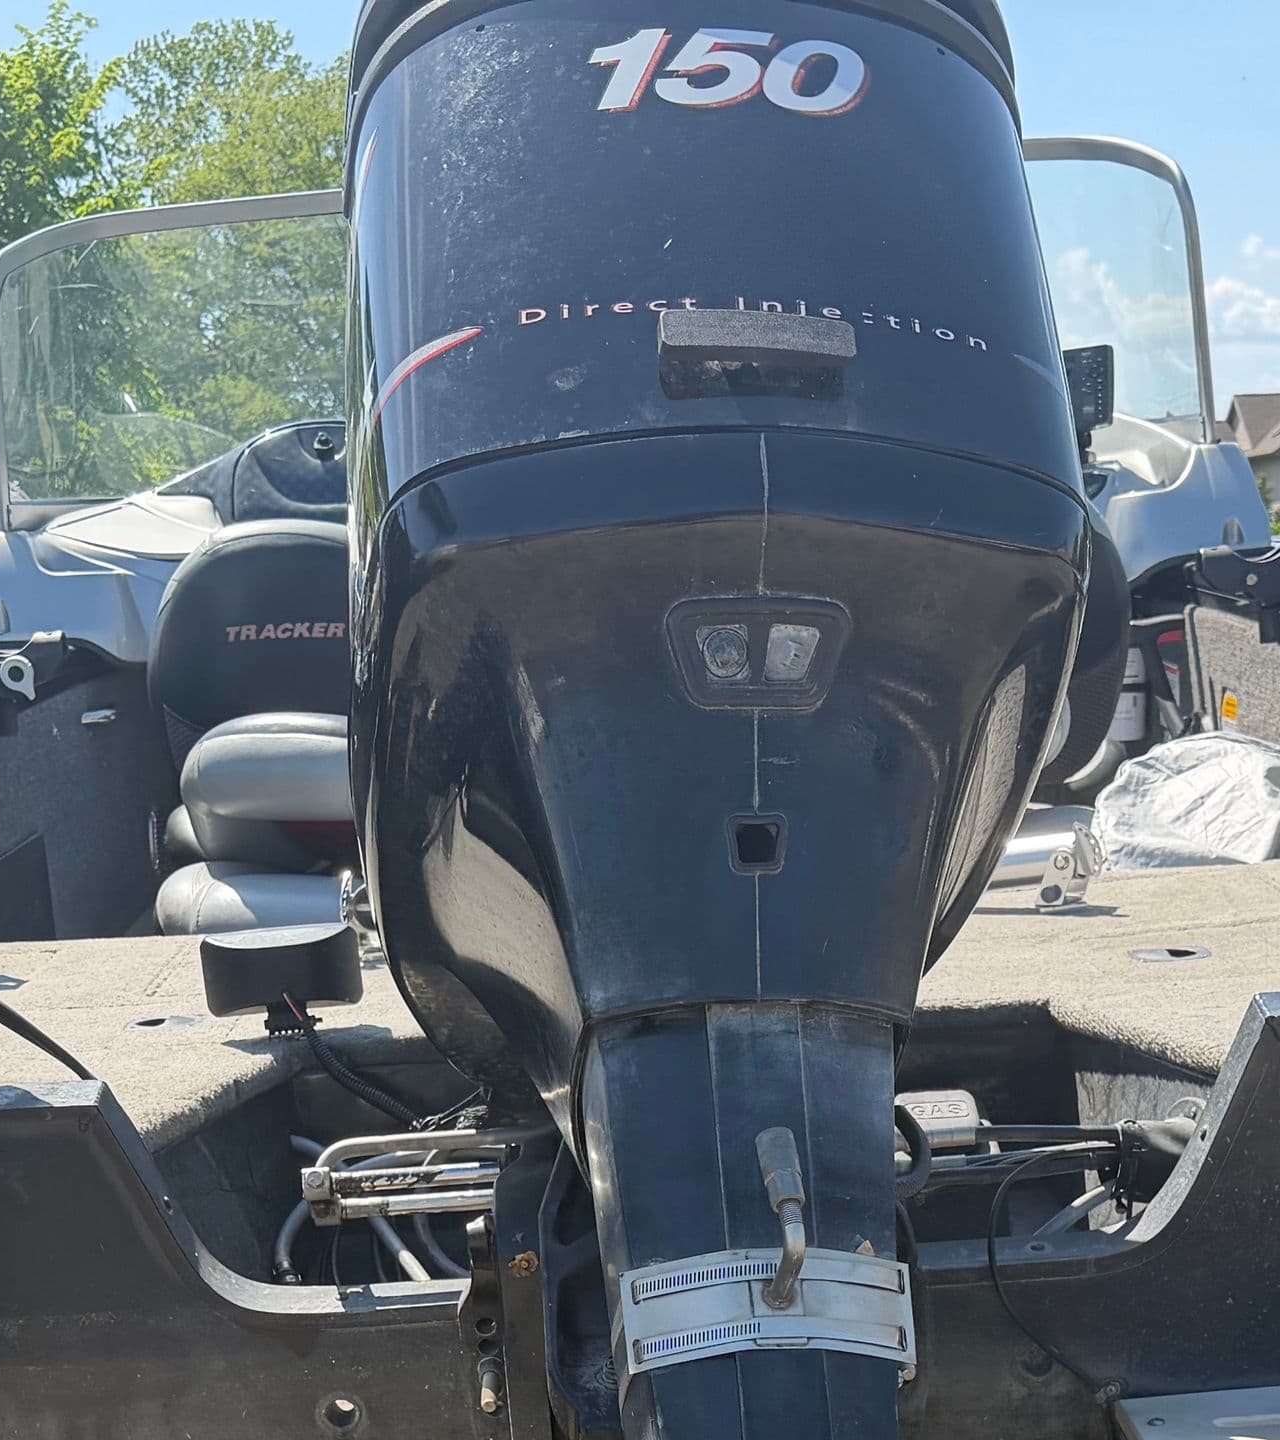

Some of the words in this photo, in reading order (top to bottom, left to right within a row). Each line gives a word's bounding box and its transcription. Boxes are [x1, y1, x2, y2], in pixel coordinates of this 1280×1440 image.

[587, 28, 868, 115] 150
[518, 297, 697, 325] Direct
[225, 622, 346, 642] TRACKER
